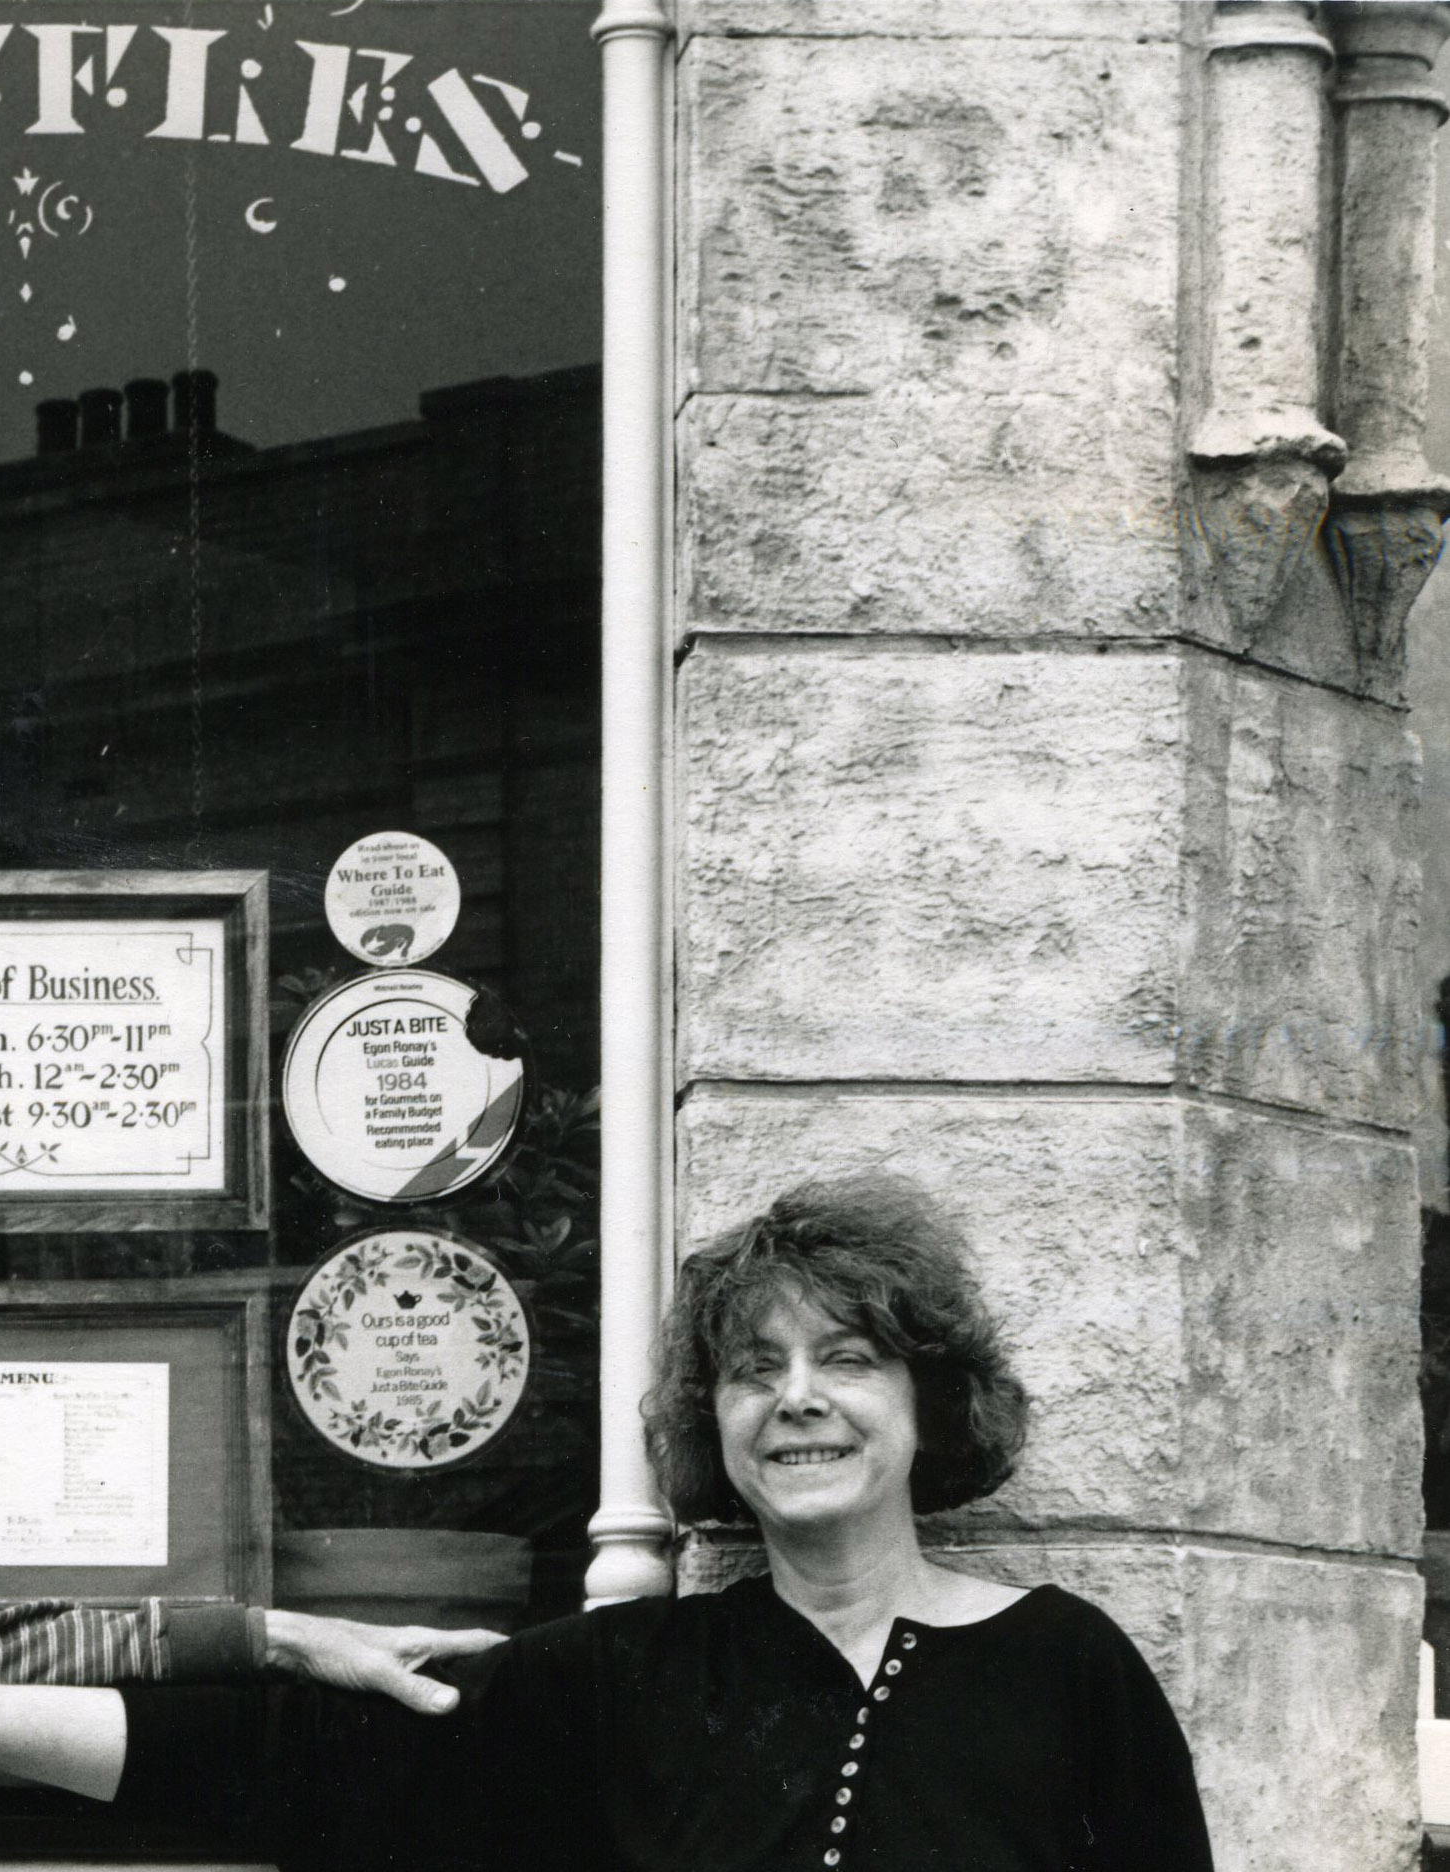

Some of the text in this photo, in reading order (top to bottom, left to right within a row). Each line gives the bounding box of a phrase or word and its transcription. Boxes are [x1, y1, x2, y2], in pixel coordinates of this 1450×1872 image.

[337, 864, 445, 882] Where To Eat
[371, 884, 413, 896] Guide
[28, 965, 160, 1001] Business.
[347, 1016, 448, 1037] JUST A BITE
[363, 1040, 437, 1056] Egon Ronay's
[366, 1055, 435, 1069] Lucas Guide
[376, 1072, 427, 1091] 1984
[365, 1093, 442, 1106] for Gourmets on
[365, 1106, 442, 1120] a Family Budget
[366, 1122, 441, 1136] Recommended
[375, 1136, 434, 1149] eating place
[361, 1310, 449, 1329] Ours is a good
[375, 1331, 437, 1349] cup of tea
[395, 1351, 420, 1364] Says
[0, 1373, 54, 1384] MENU
[376, 1367, 403, 1379] Egon
[370, 1381, 390, 1393] Just
[399, 1380, 419, 1391] Bite
[420, 1379, 448, 1391] Guide
